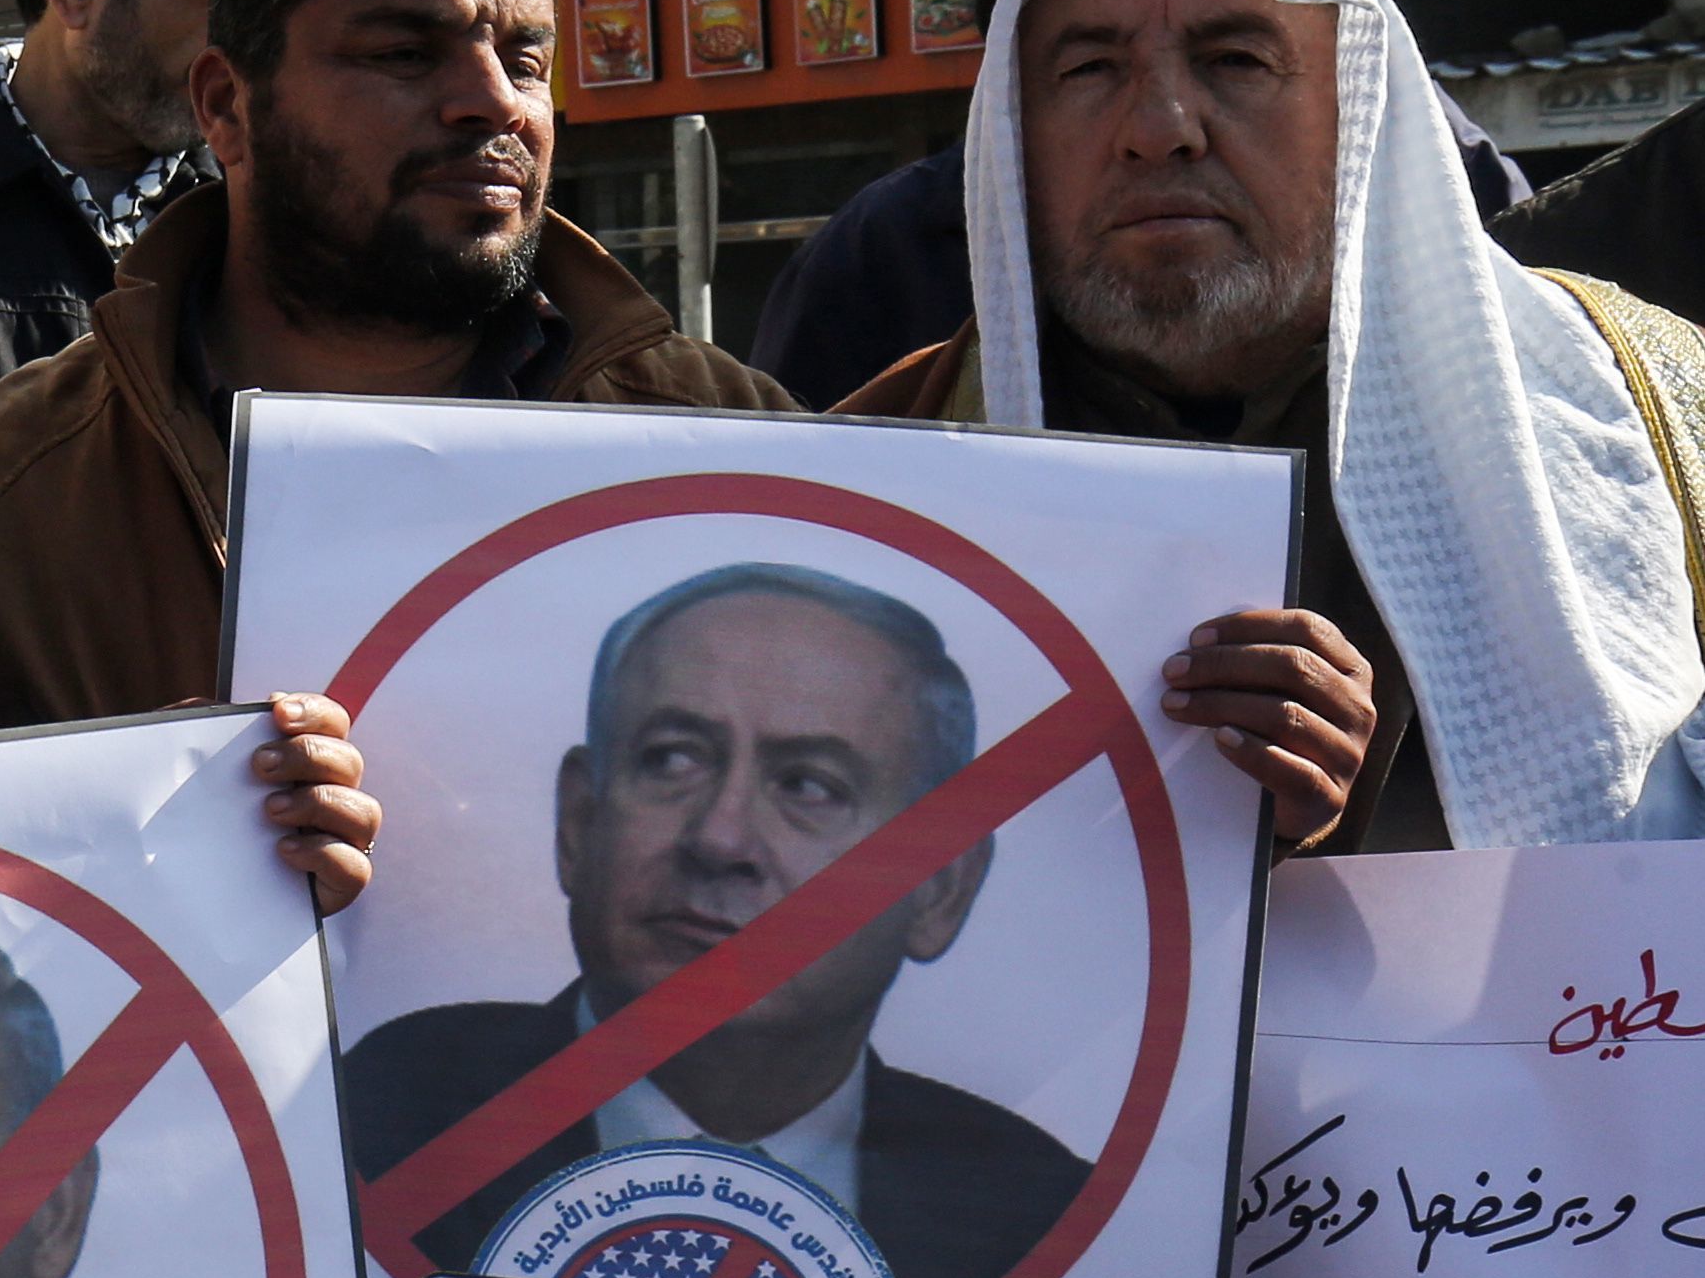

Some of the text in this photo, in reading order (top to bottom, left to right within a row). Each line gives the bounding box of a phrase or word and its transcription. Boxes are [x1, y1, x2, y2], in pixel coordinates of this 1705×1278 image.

[593, 1172, 706, 1220] فلسطين
[713, 1176, 796, 1232] عاصمة
[512, 1191, 593, 1276] الأبدية
